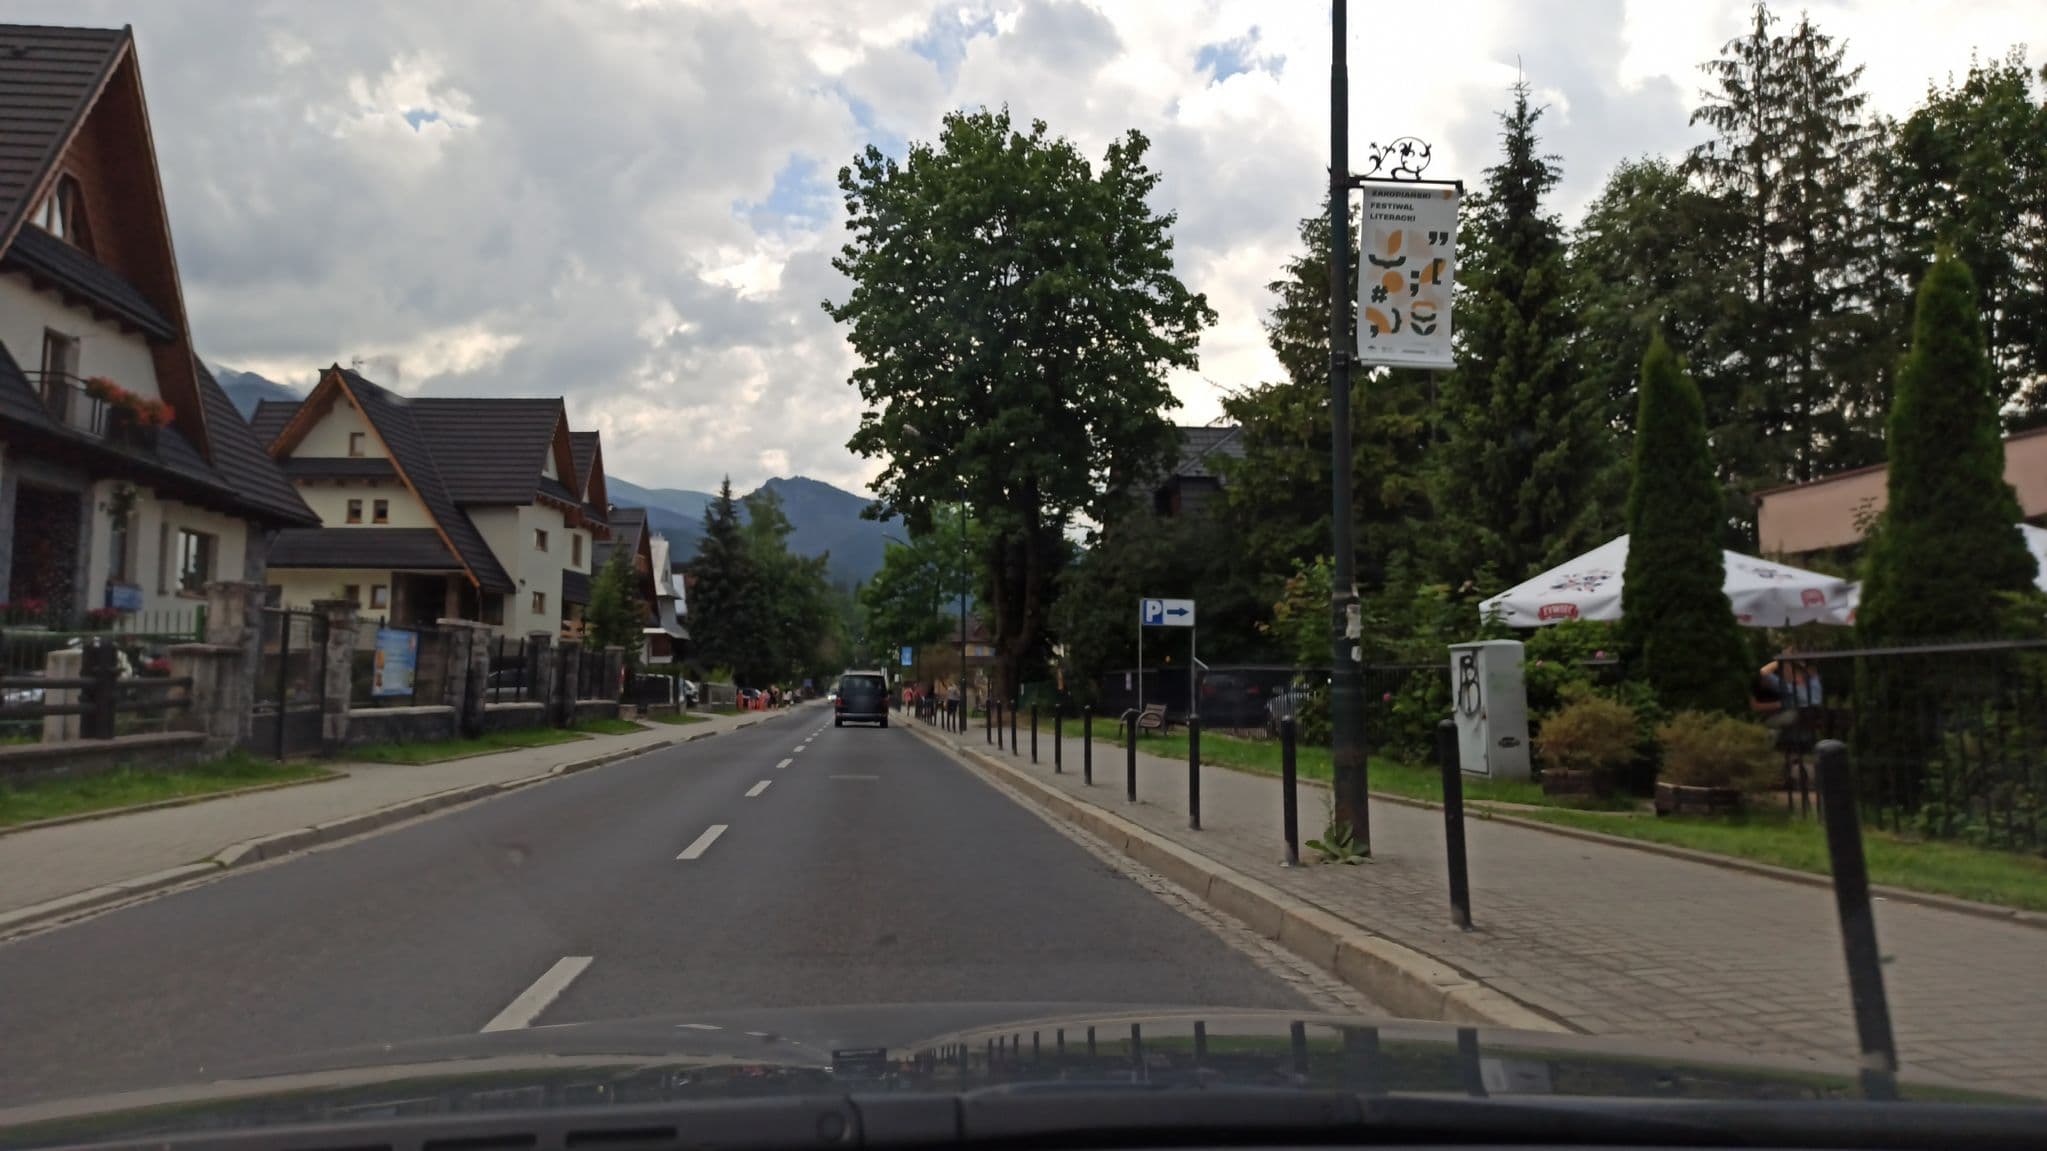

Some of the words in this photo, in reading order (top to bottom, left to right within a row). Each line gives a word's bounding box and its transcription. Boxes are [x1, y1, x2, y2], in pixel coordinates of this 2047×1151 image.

[1370, 202, 1415, 211] FESTIWAL
[1370, 213, 1416, 222] LITERACKI
[1146, 600, 1162, 622] P
